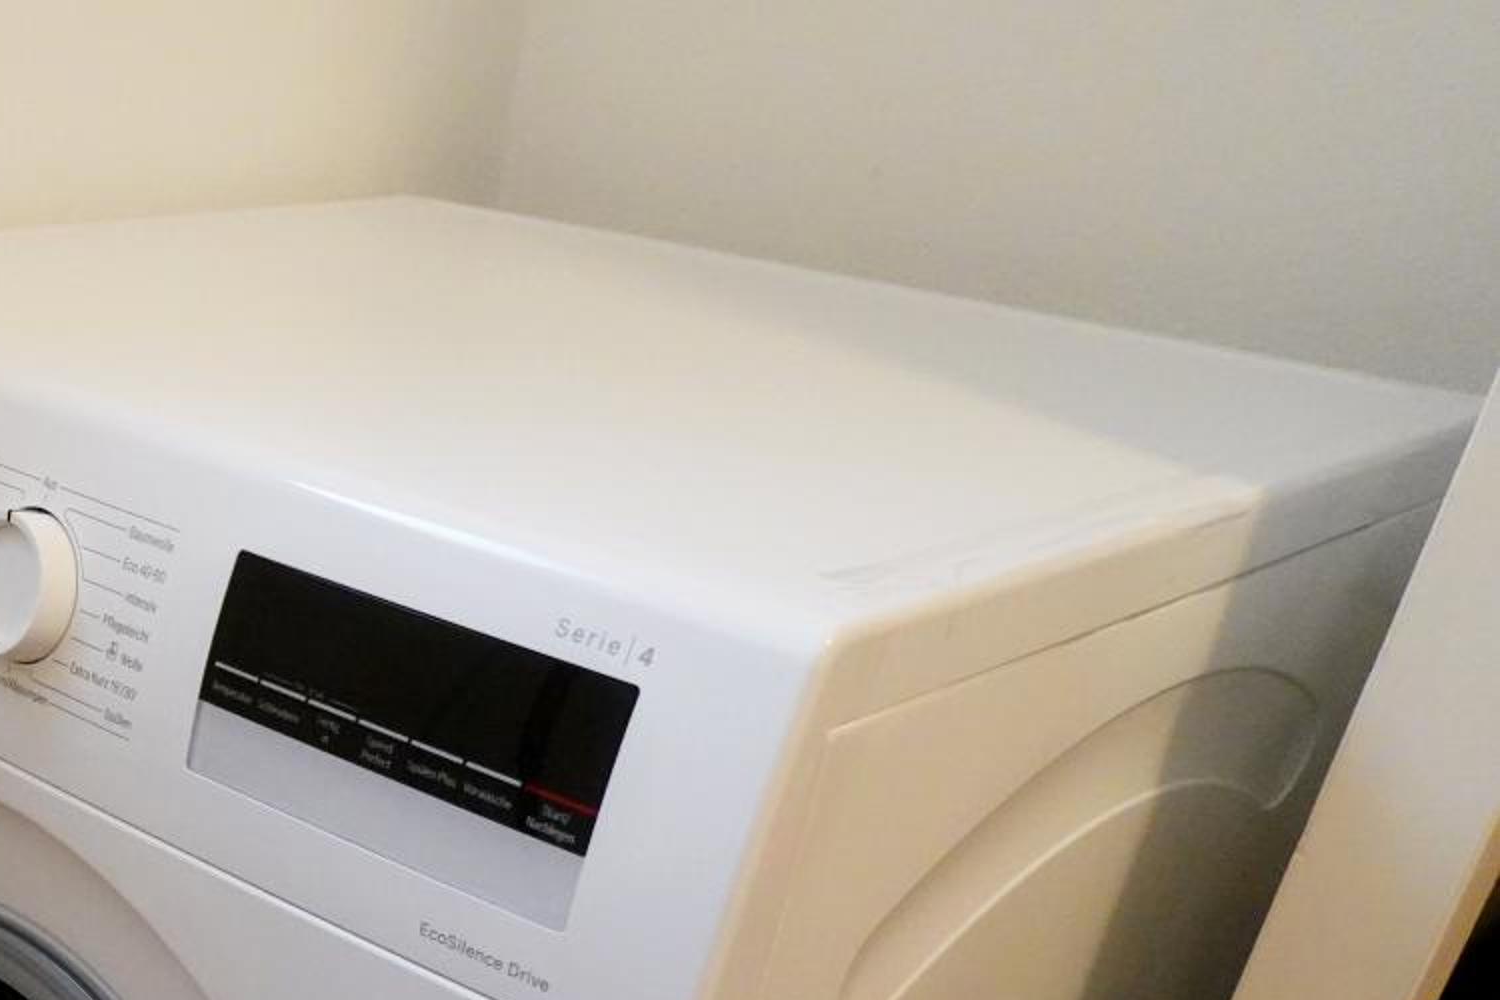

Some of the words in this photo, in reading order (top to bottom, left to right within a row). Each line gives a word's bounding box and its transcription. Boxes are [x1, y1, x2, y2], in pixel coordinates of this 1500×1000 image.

[122, 556, 138, 573] Eco
[555, 617, 622, 657] Serie
[637, 646, 656, 667] 4
[419, 920, 503, 971] EcoSilence
[507, 961, 549, 993] Drive
